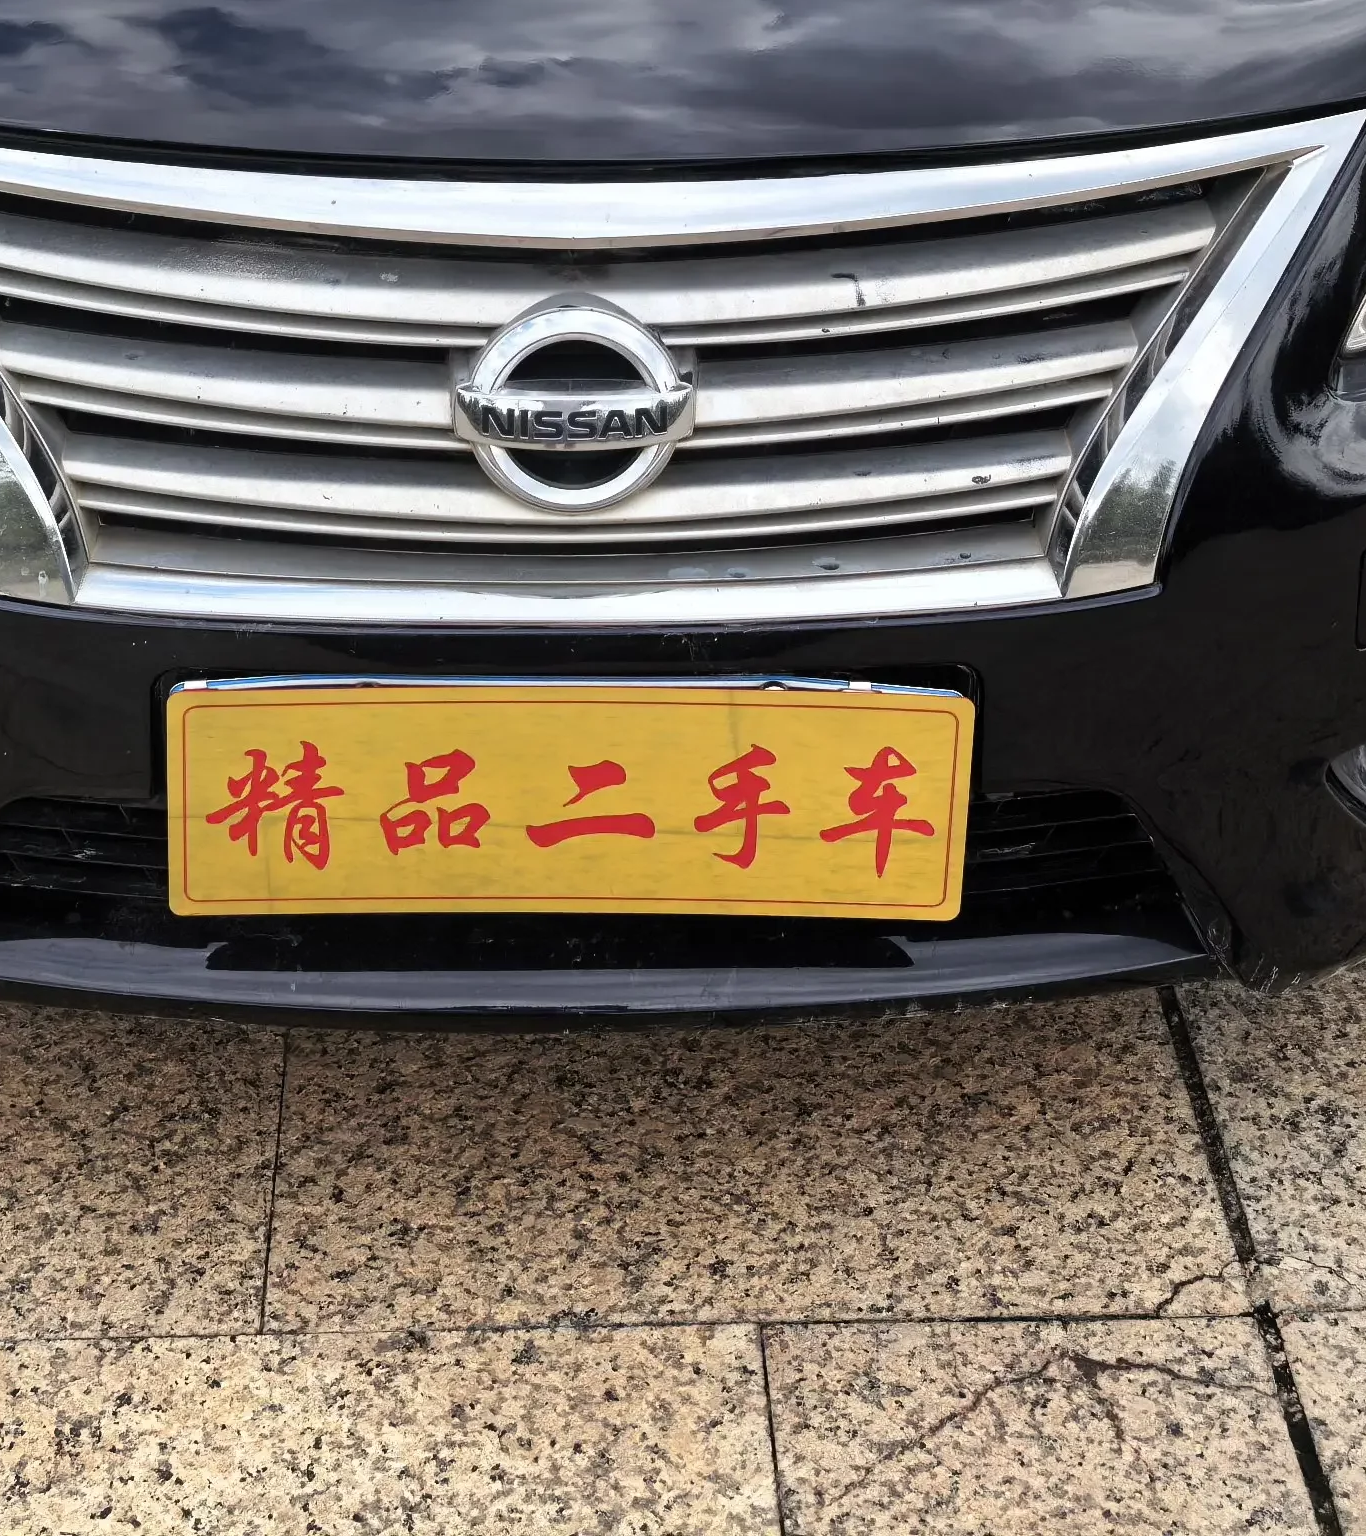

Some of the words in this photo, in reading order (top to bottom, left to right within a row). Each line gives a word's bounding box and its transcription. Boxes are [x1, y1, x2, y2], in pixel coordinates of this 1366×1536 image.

[481, 405, 668, 440] NISSAN
[206, 743, 934, 877] 精品二手车
